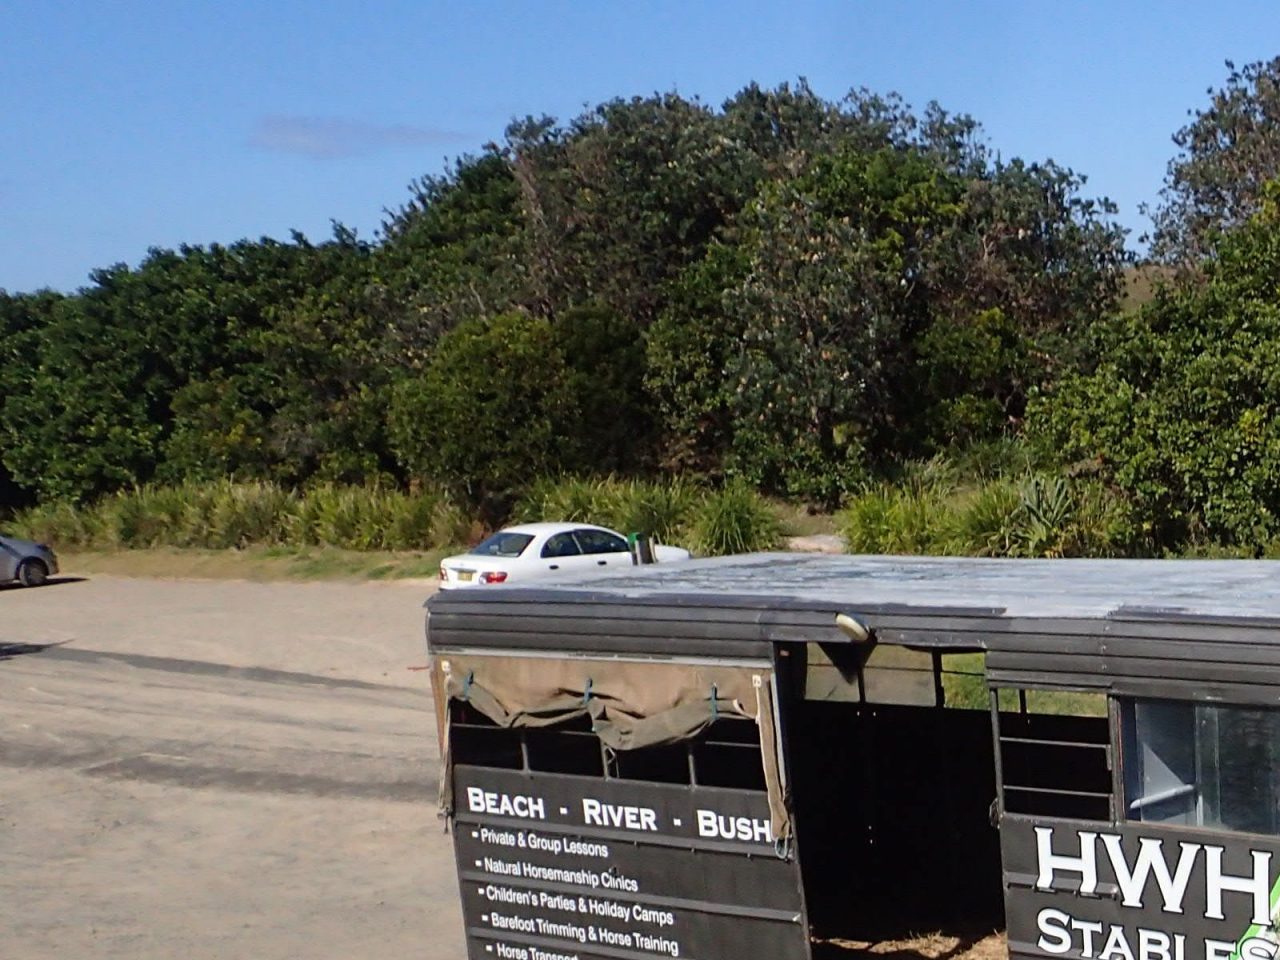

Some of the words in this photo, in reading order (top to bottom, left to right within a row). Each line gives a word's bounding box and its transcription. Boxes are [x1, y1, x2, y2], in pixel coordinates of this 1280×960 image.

[467, 787, 545, 819] BEACH
[583, 798, 658, 831] RIVER
[697, 809, 772, 842] BUSH
[480, 828, 516, 847] Private
[517, 833, 527, 848] &
[527, 834, 561, 855] Group
[563, 838, 608, 858] Lessons
[484, 857, 521, 876] Natural
[523, 863, 599, 889] Horsemanship
[600, 872, 638, 892] Clinics
[1034, 826, 1273, 926] HWH
[486, 885, 538, 906] Children's
[540, 893, 576, 912] Parties
[578, 898, 588, 913] &
[589, 899, 630, 922] Holiday
[632, 905, 674, 927] Camps
[491, 912, 535, 932] Barefoot
[536, 918, 586, 943] Trimming
[588, 926, 597, 942] &
[599, 927, 632, 947] Horse
[633, 933, 679, 957] Training
[496, 943, 528, 960] Horse
